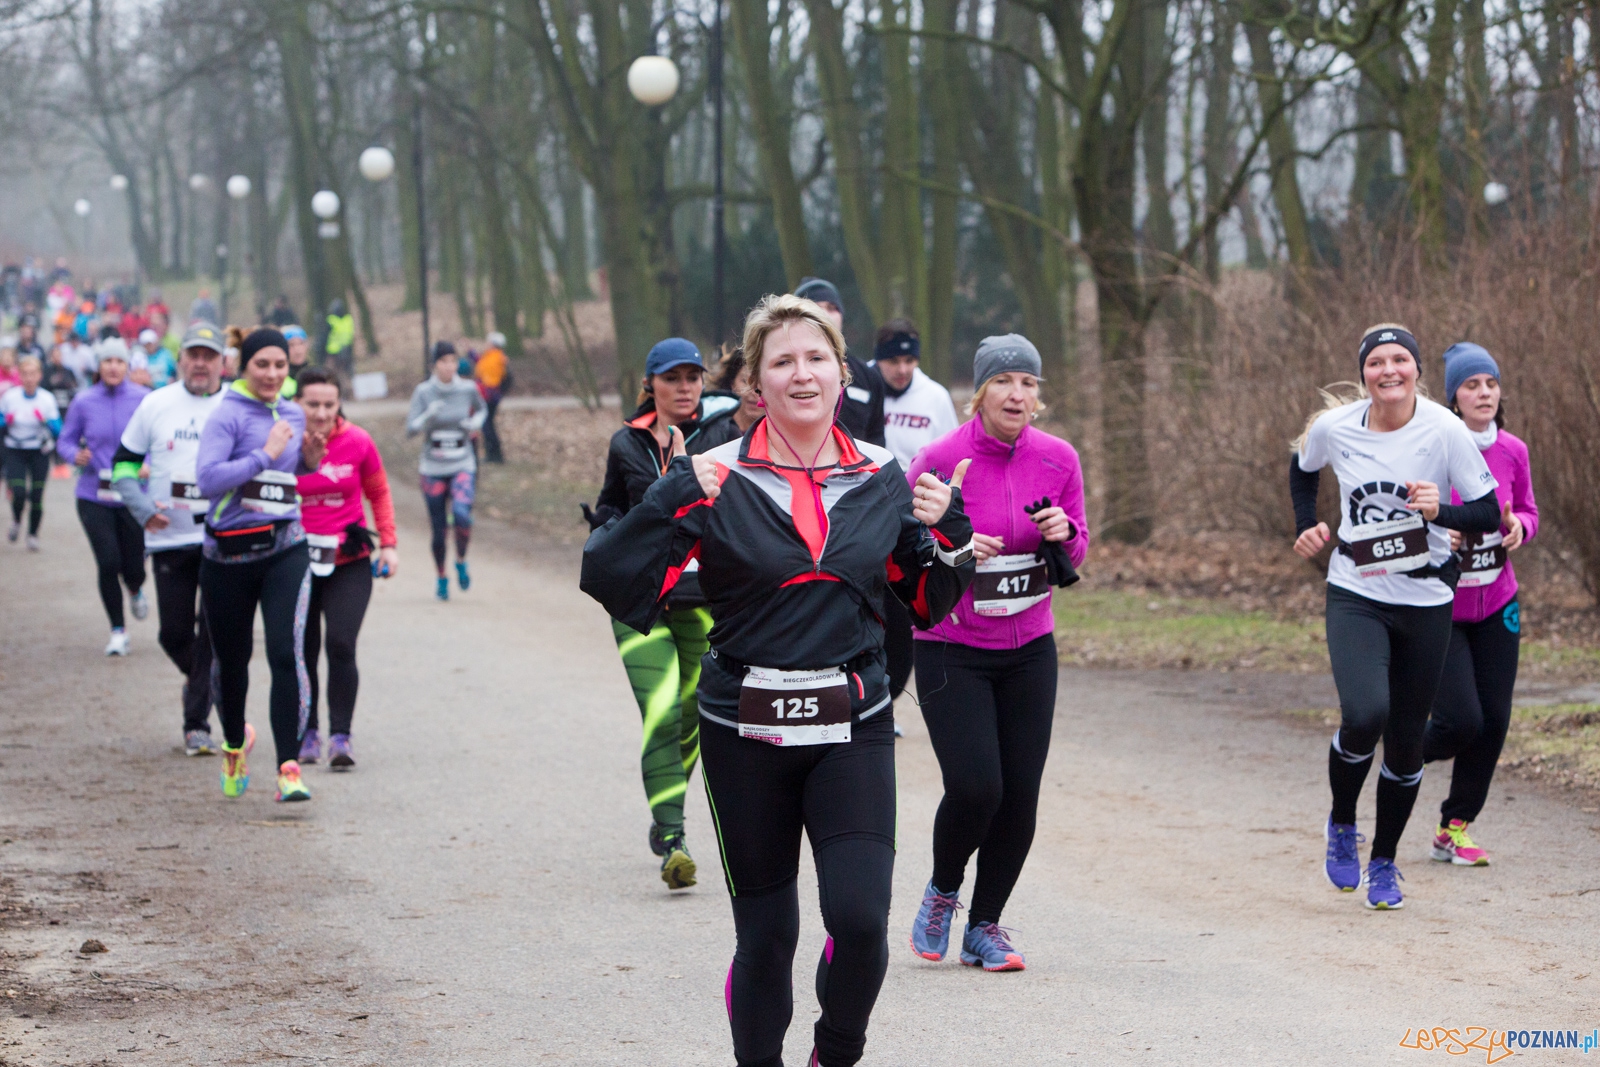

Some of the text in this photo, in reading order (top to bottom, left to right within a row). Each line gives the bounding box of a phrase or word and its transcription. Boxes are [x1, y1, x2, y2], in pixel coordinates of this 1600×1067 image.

[1372, 537, 1406, 558] 655
[1471, 550, 1496, 569] 264
[996, 574, 1030, 594] 417
[783, 673, 842, 683] BIEGCZEKOLADOWY.PL
[771, 697, 819, 719] 125
